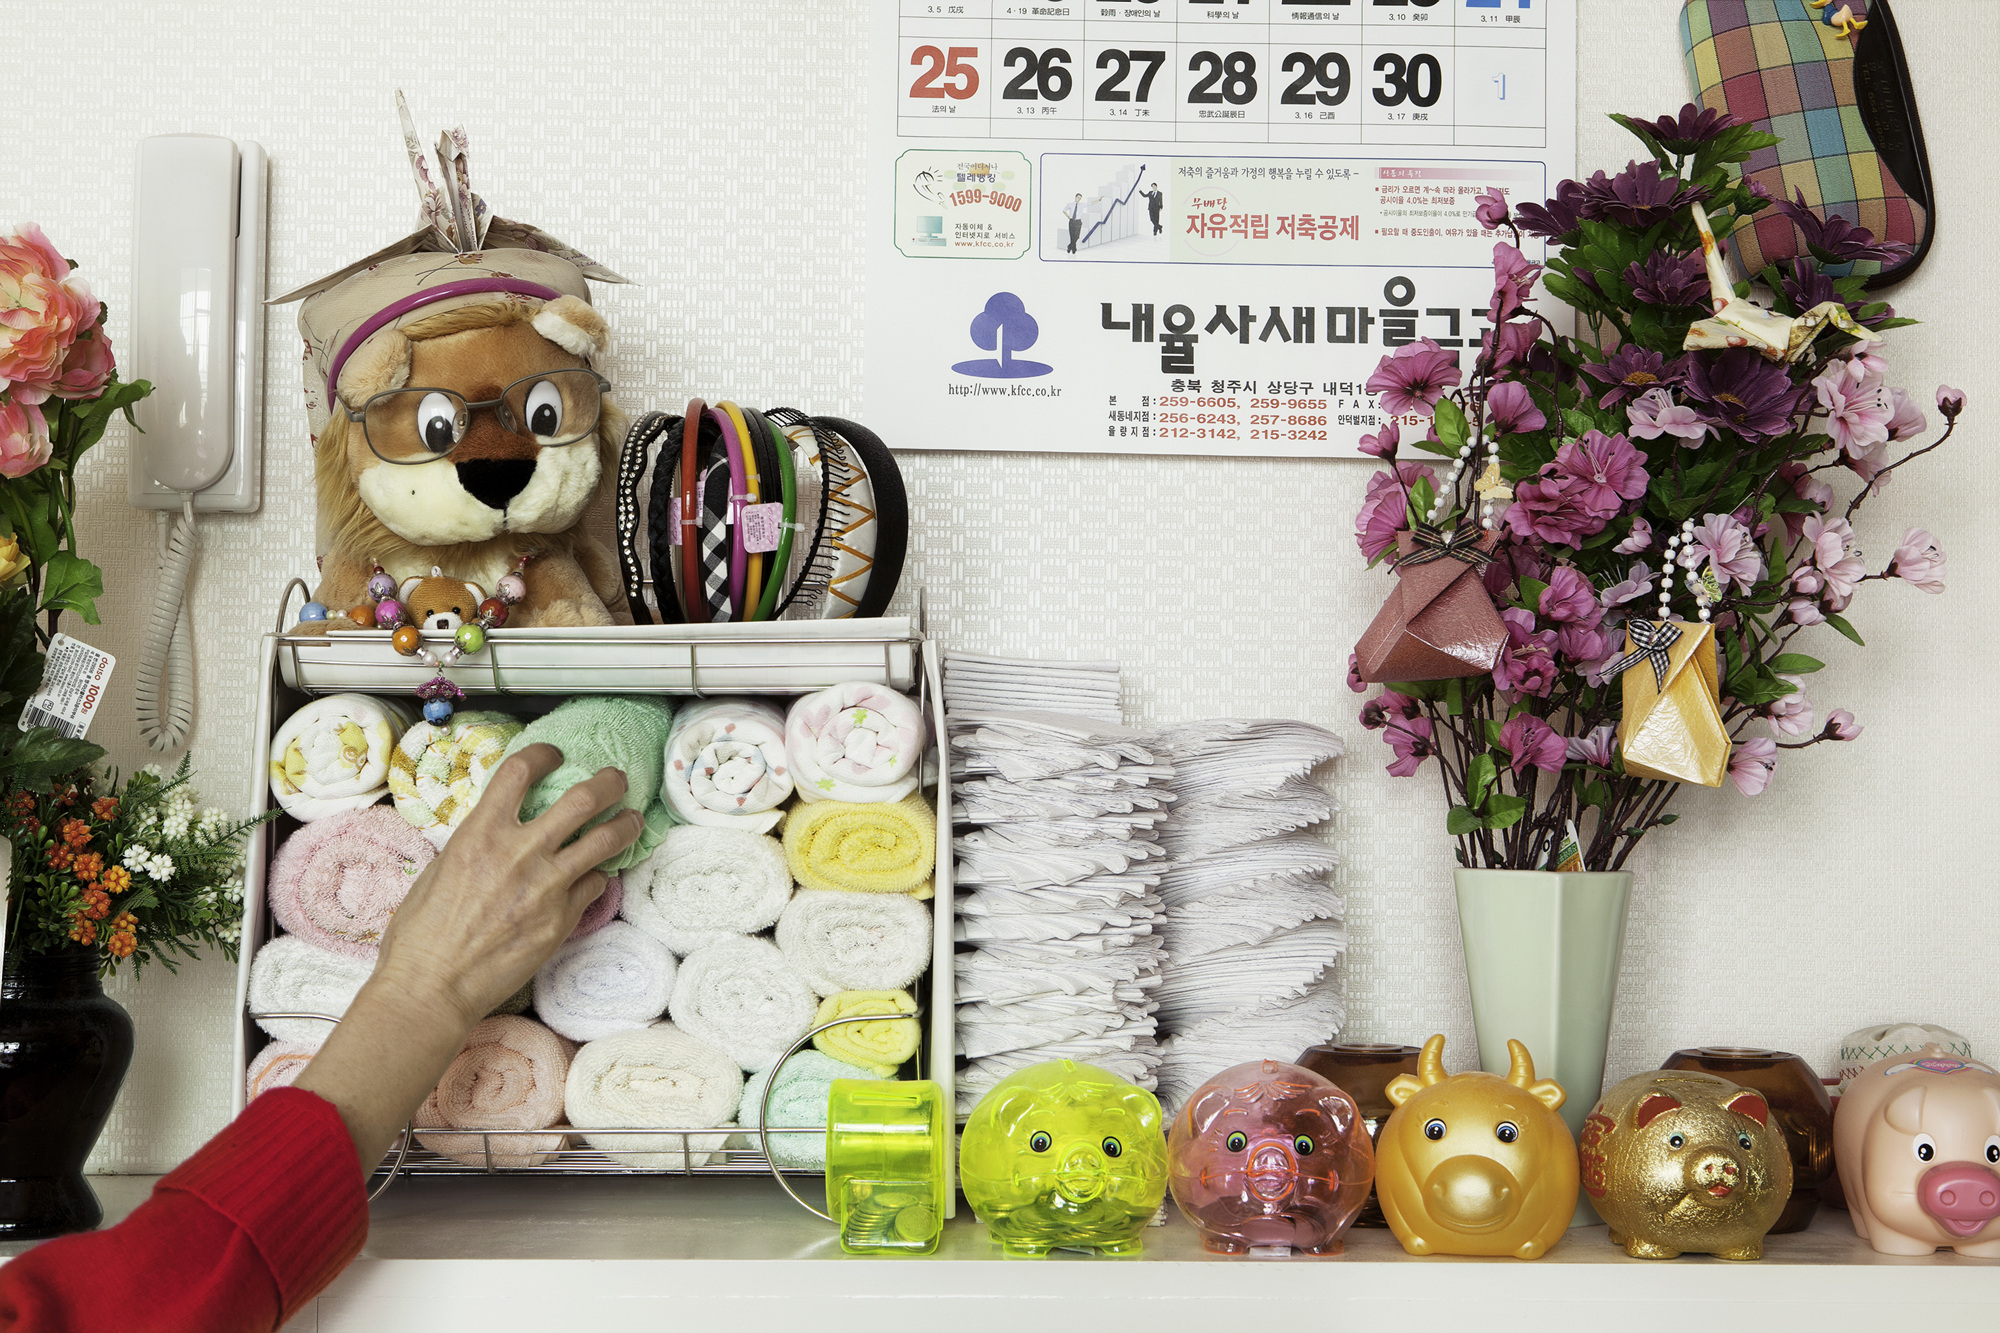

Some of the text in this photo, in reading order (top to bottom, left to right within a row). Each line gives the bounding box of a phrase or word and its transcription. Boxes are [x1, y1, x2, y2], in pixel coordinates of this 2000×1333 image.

[1032, 8, 1070, 16] 革命記念日
[1124, 10, 1152, 18] 장애인의
[1154, 10, 1160, 18] 날
[1206, 10, 1240, 20] 科學의 날
[1292, 12, 1340, 20] 情報通信의 날
[908, 44, 980, 100] 25
[1002, 46, 1072, 102] 26
[1094, 48, 1166, 102] 27
[1188, 50, 1258, 106] 28
[1280, 52, 1352, 106] 29
[1372, 52, 1442, 108] 30
[1492, 72, 1506, 100] 1
[932, 104, 956, 114] 法의 날
[1198, 110, 1246, 118] 忠武公誕辰日
[957, 172, 996, 183] 텔레뱅킹
[1178, 166, 1352, 180] 저축의 즐거움과 가정의 행복을 누릴 수 있도록
[1382, 185, 1400, 194] 금리가
[1402, 186, 1420, 194] 오르면
[1423, 186, 1441, 194] 계~속
[1443, 186, 1456, 195] 따라
[1458, 186, 1484, 196] 올라가고,
[949, 188, 1022, 212] 1599-9000
[1192, 197, 1228, 210] 무배당
[1380, 196, 1456, 206] 공시이율 4.0%는 최저보증
[954, 222, 984, 231] 자동이체
[1186, 212, 1360, 241] 자유적립 저축공제
[1381, 228, 1400, 236] 필요할
[1402, 228, 1409, 236] 때
[1446, 228, 1464, 237] 여유가
[1466, 228, 1478, 238] 있을
[1480, 229, 1493, 238] 때는
[1495, 230, 1525, 238] 추가납이
[954, 231, 1016, 240] 인터넷지로 서비스
[954, 240, 1014, 248] www.kfcc.co.kr
[948, 382, 1062, 398] http://www.kfcc.co.kr
[1170, 378, 1378, 396] 충북 청주시 상당구 내덕1
[1159, 397, 1241, 410] 259-6605,
[1250, 398, 1328, 410] 259-9655
[1108, 410, 1156, 422] 새동네지점:
[1159, 412, 1241, 426] 256-6243,
[1250, 414, 1328, 426] 257-8686
[1159, 428, 1241, 441] 212-3142,
[1250, 429, 1328, 441] 215-3242
[81, 656, 108, 715] daiso 1000원
